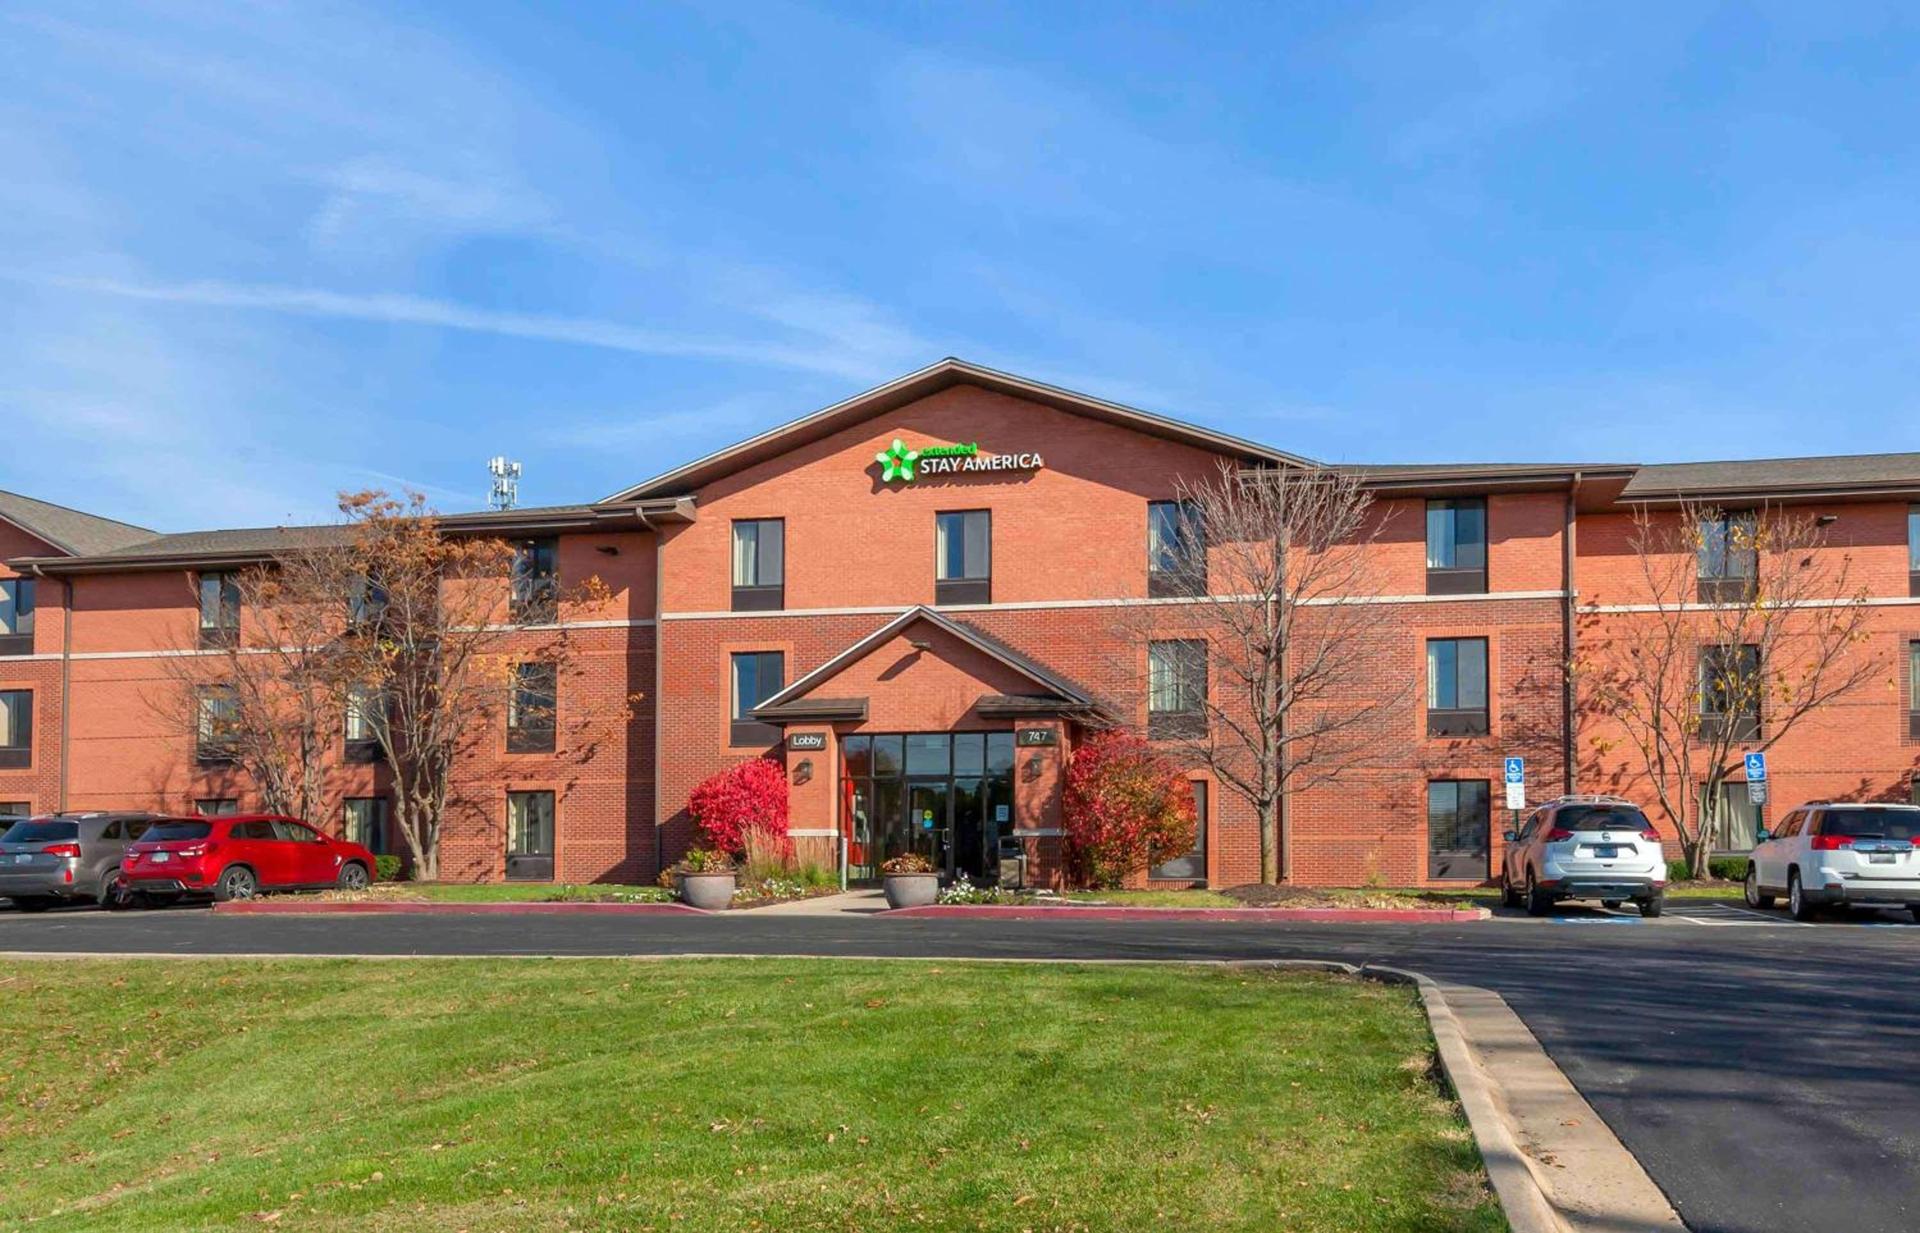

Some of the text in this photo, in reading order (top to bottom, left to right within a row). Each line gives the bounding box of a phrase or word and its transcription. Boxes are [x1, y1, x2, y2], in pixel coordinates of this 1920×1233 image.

[921, 442, 977, 456] extended
[920, 453, 1043, 474] STAY AMERICA
[793, 736, 822, 747] Lobby
[1028, 731, 1048, 741] 747
